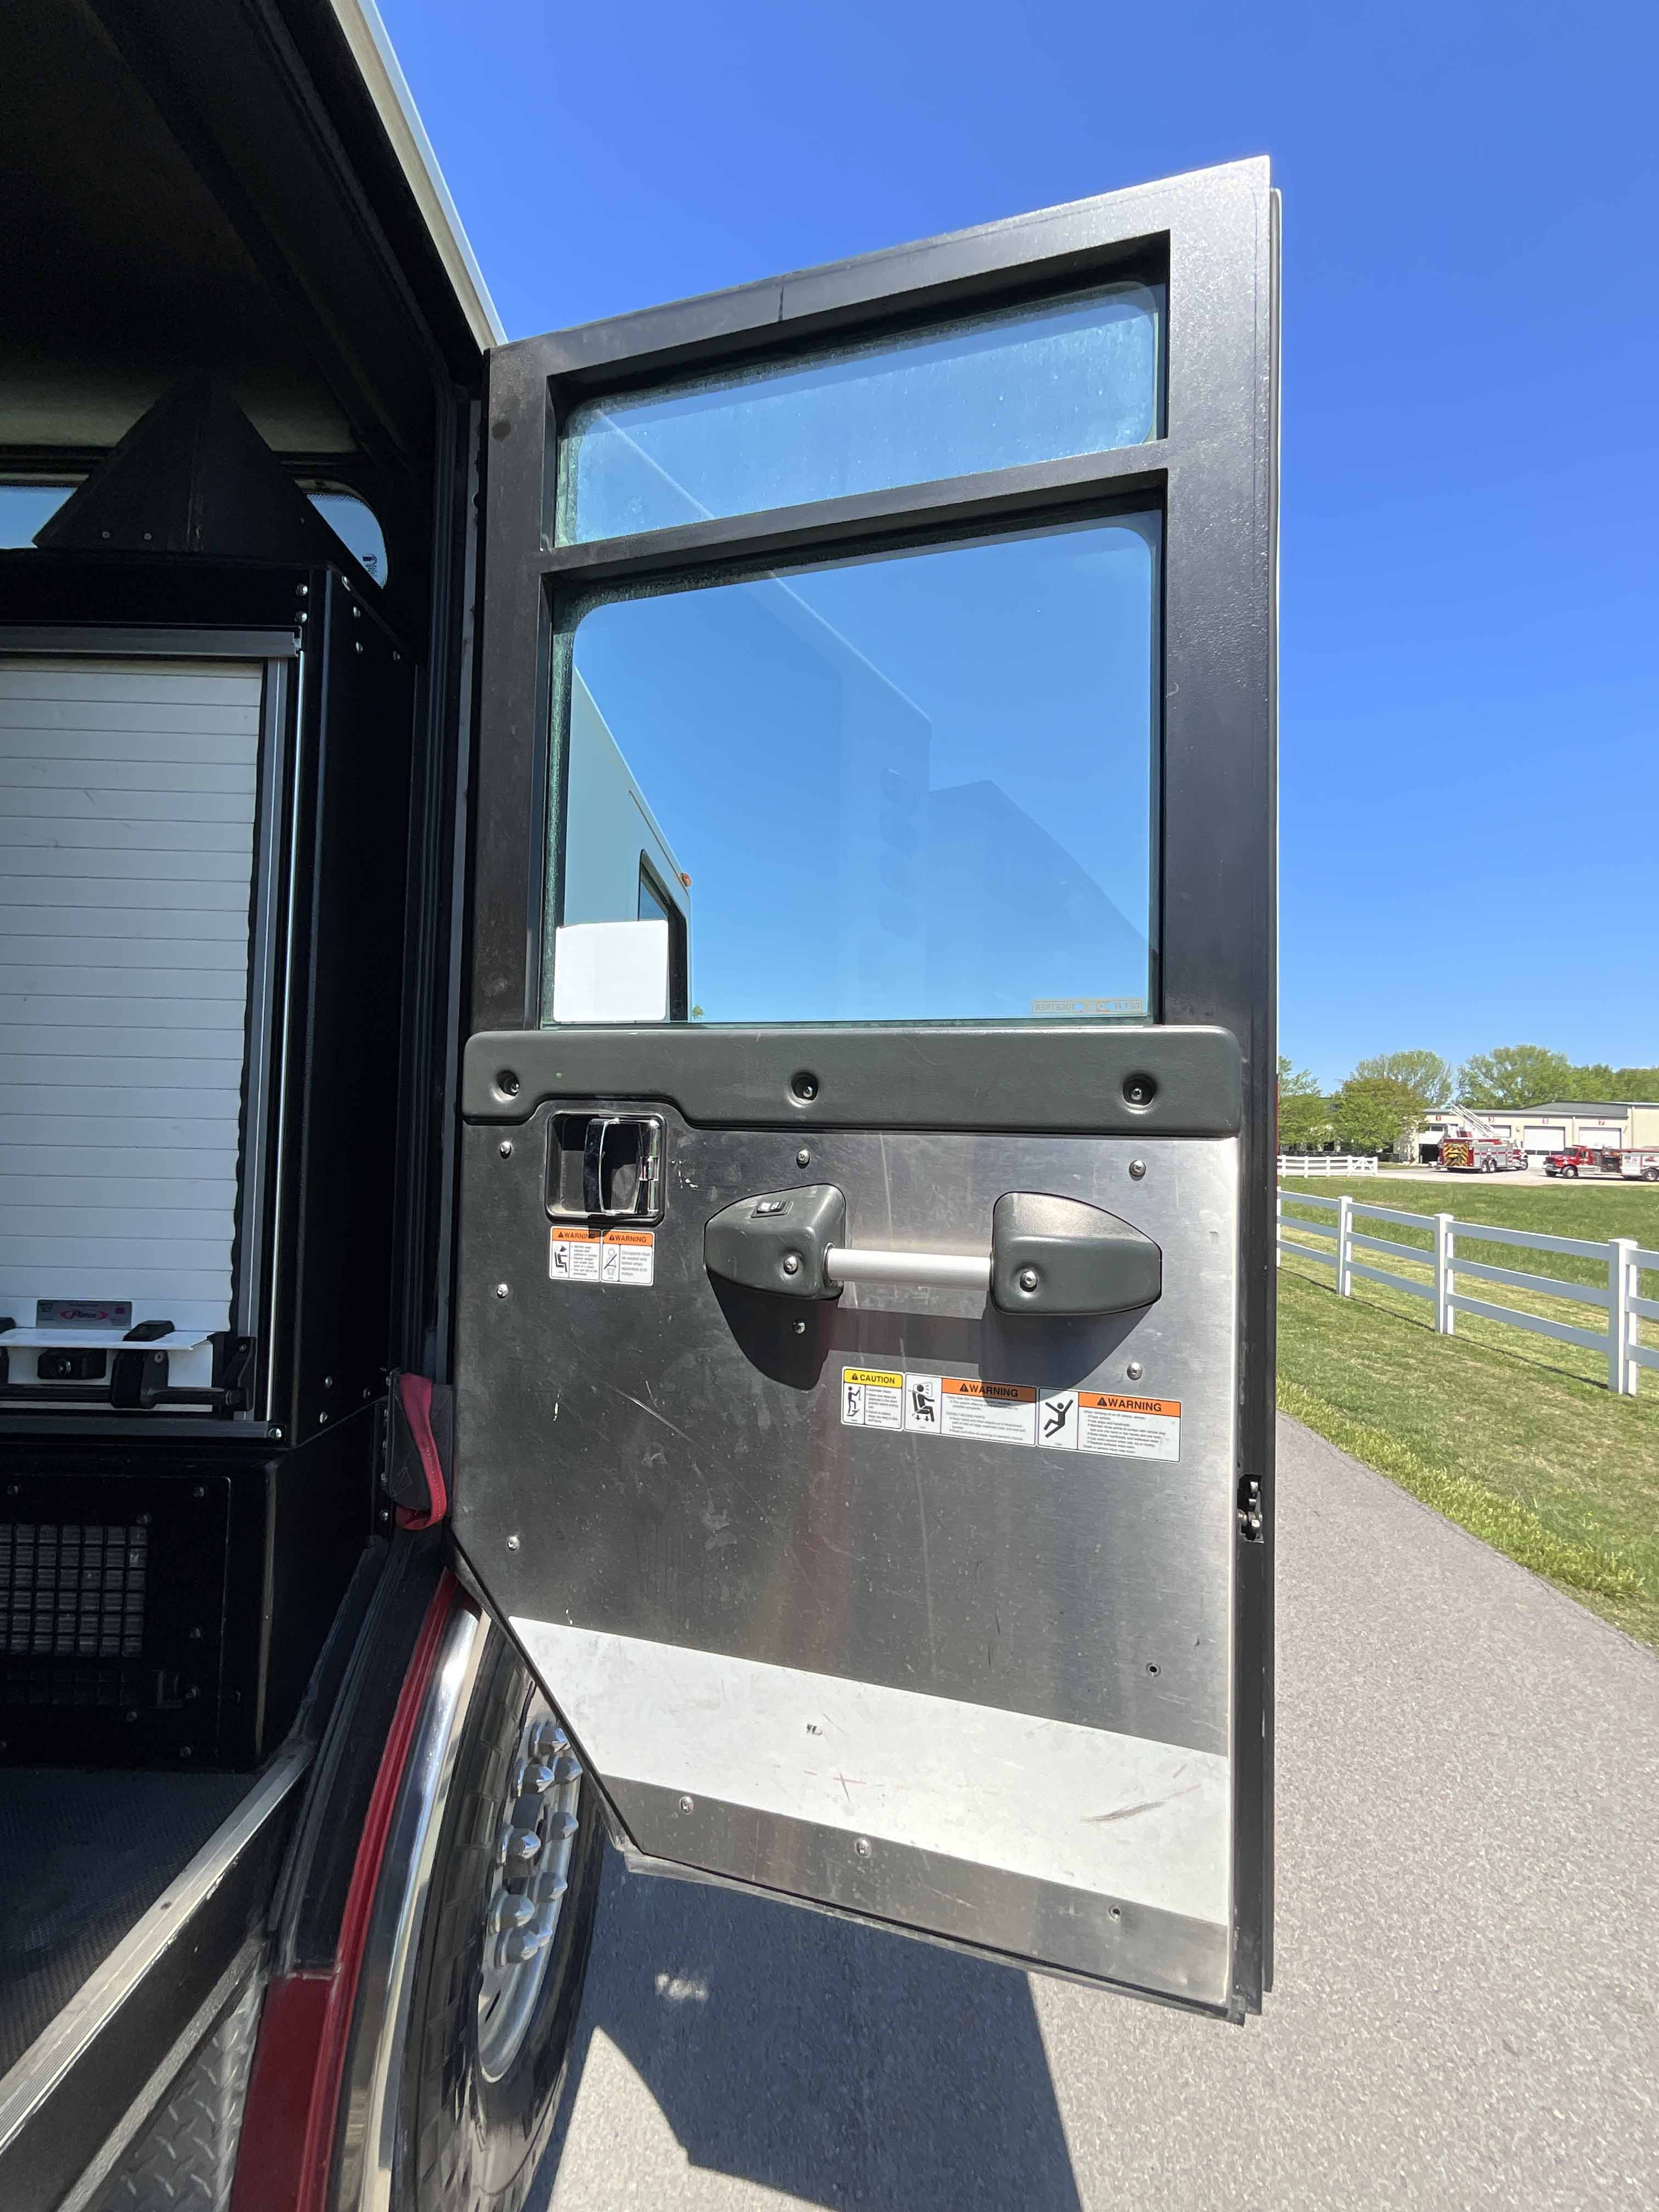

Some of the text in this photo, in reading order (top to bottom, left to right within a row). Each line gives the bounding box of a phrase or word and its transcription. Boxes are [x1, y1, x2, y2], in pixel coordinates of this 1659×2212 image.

[860, 1374, 895, 1384] CAUTION
[969, 1384, 1018, 1397] WARNING
[1108, 1398, 1162, 1412] WARNING
